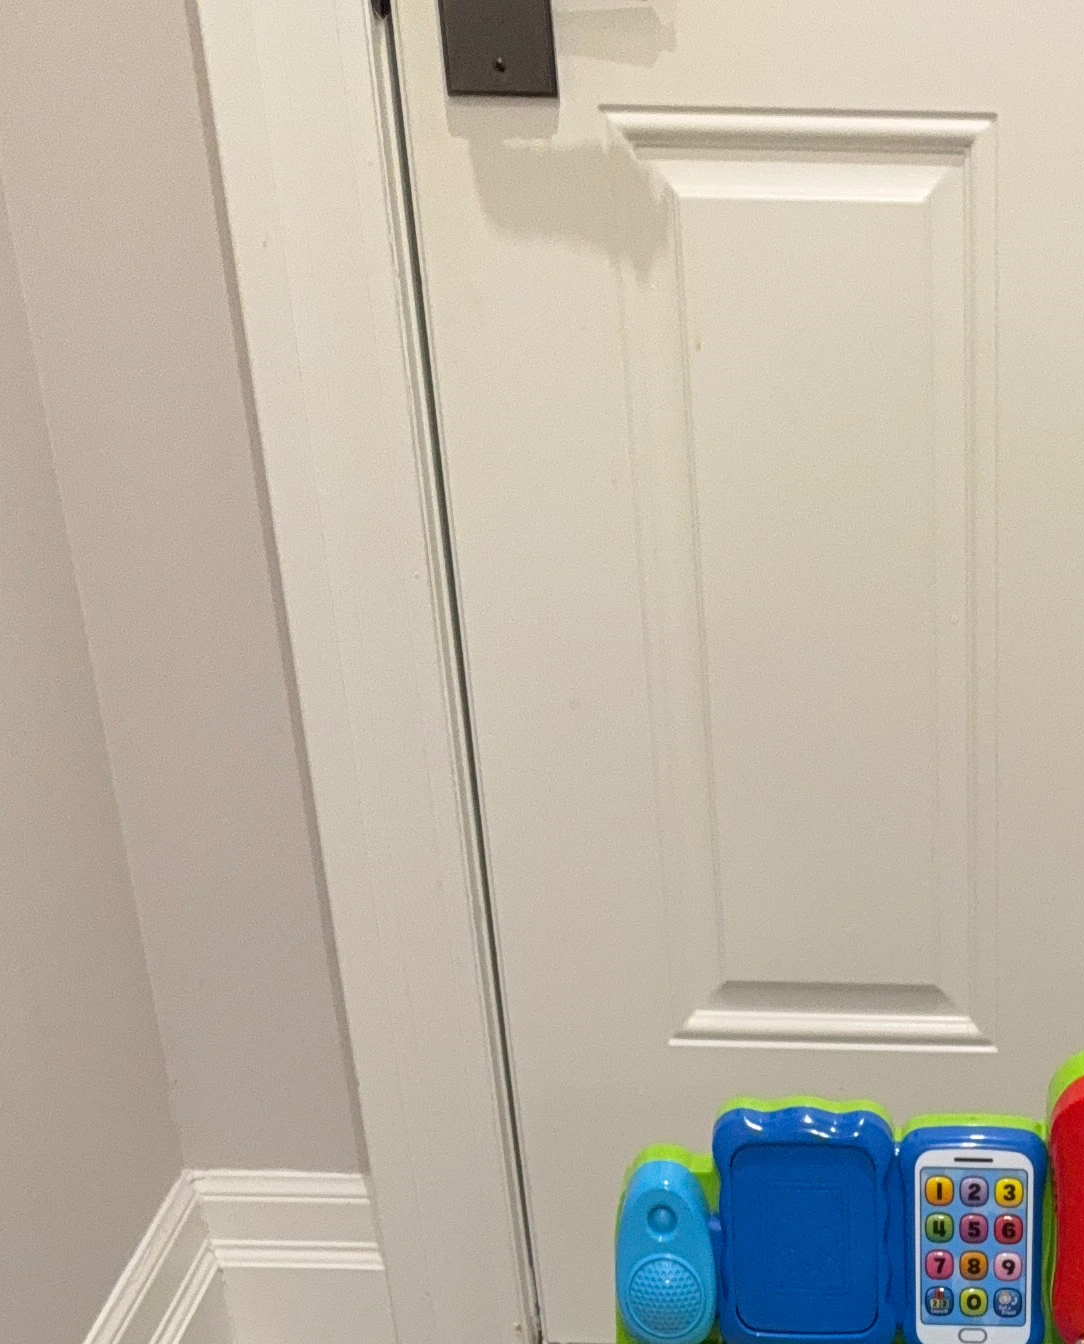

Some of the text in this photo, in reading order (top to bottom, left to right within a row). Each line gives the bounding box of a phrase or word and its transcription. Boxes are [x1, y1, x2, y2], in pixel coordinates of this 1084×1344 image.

[936, 1183, 942, 1200] 1
[967, 1183, 981, 1201] 2
[1003, 1184, 1016, 1201] 3
[932, 1220, 947, 1237] 4
[967, 1222, 981, 1238] 5
[1002, 1222, 1016, 1239] 6
[933, 1258, 946, 1274] 7
[967, 1258, 981, 1275] 8
[1002, 1259, 1016, 1275] 9
